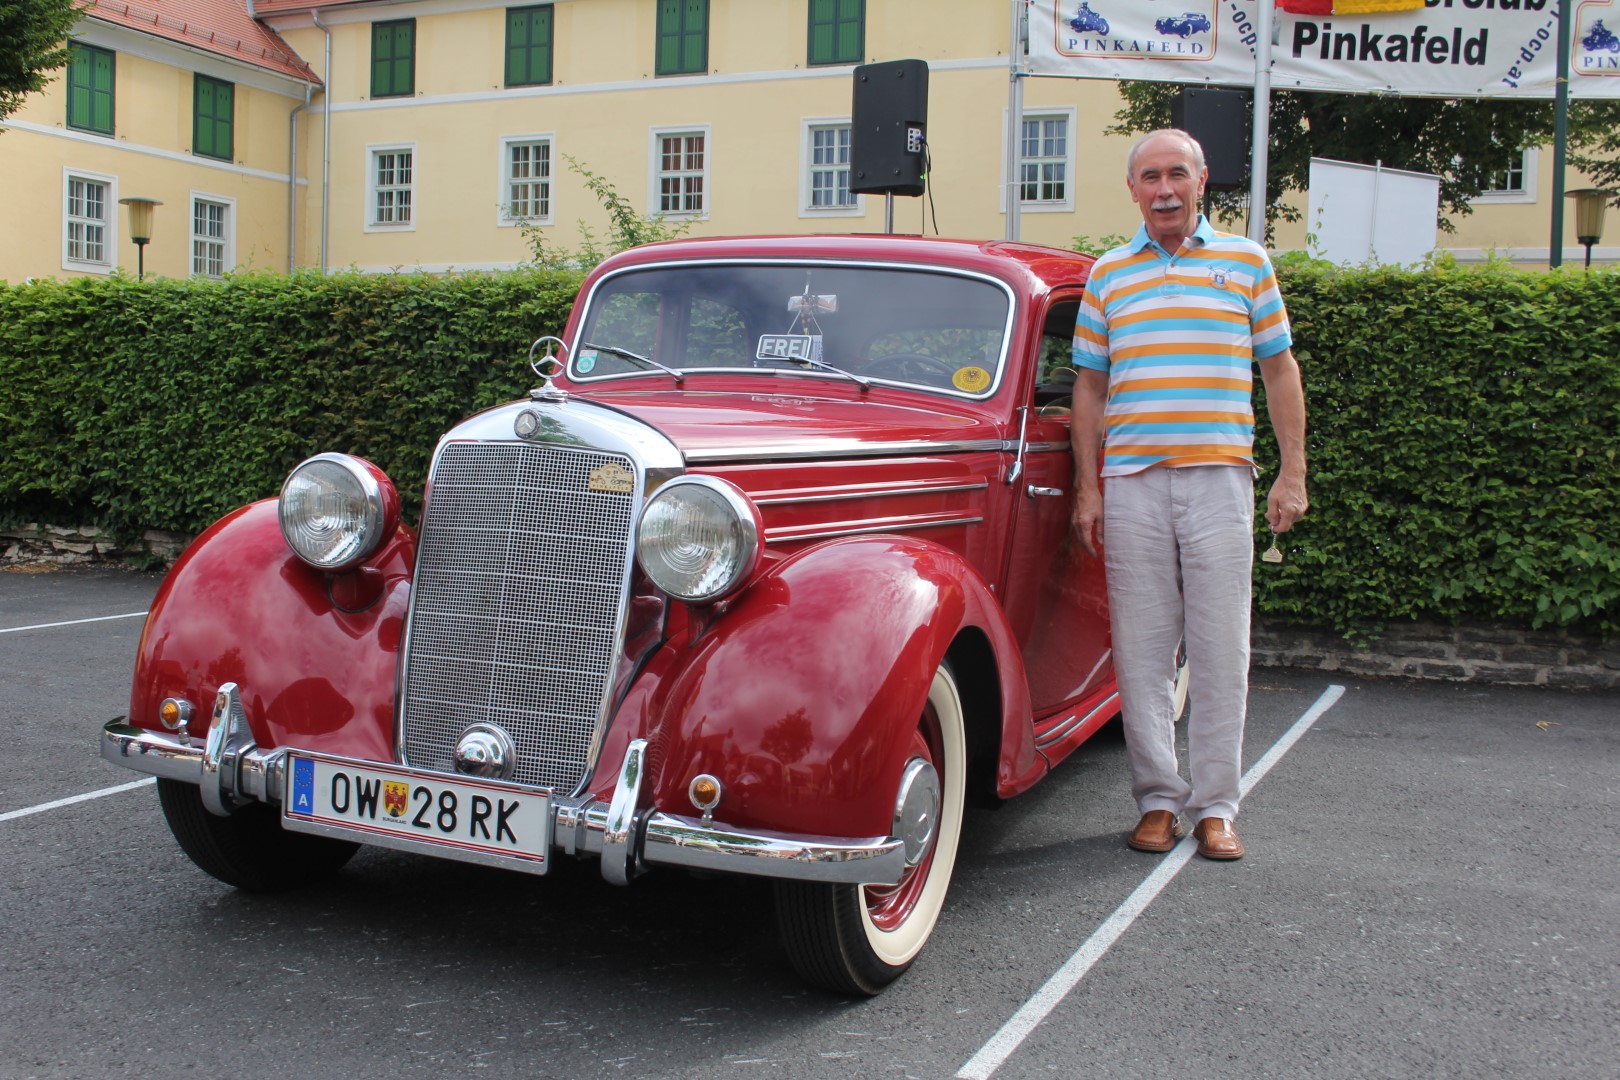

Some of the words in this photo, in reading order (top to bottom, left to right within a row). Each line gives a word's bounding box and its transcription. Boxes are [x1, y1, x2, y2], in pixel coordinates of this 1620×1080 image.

[1068, 38, 1204, 54] PINKAFELD
[1292, 21, 1488, 66] Pinkafeld
[761, 338, 808, 358] FREI
[298, 793, 308, 807] A
[331, 772, 381, 819] OW
[411, 785, 458, 833] 28
[470, 794, 520, 844] RK
